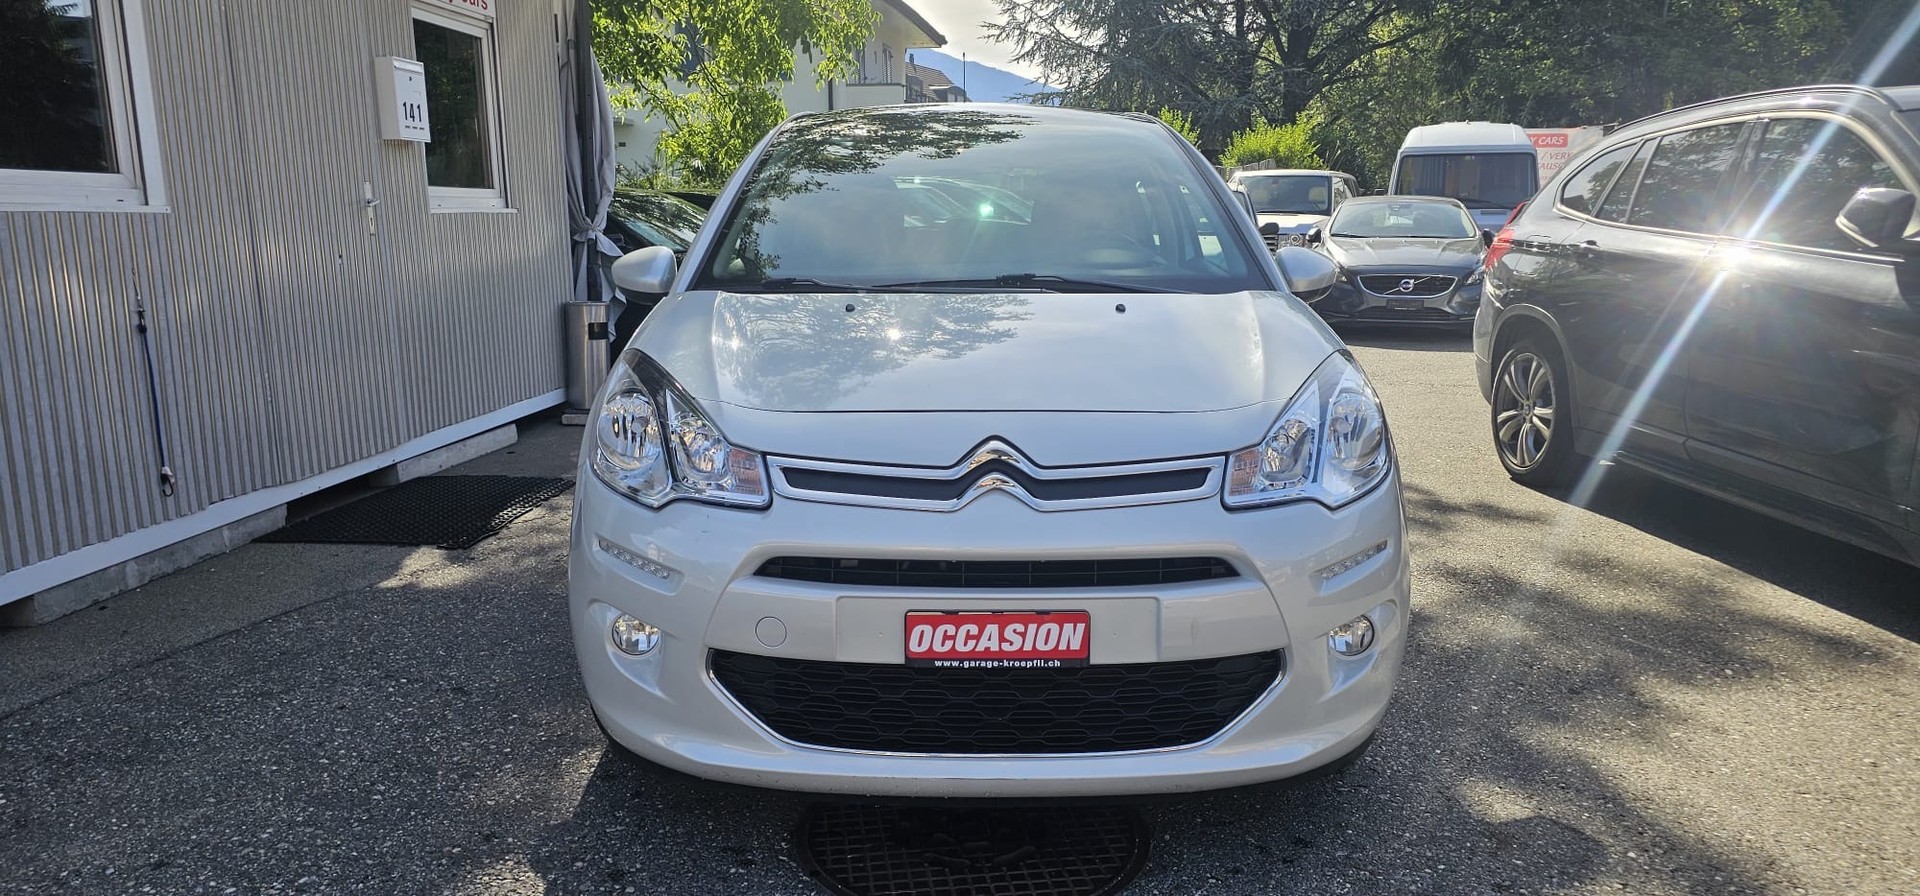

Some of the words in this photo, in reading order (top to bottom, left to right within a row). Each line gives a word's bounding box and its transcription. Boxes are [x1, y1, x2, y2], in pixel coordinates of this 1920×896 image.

[462, 0, 488, 10] ars
[403, 101, 422, 122] 141
[1539, 136, 1565, 145] CARS
[908, 622, 1086, 653] OCCASION
